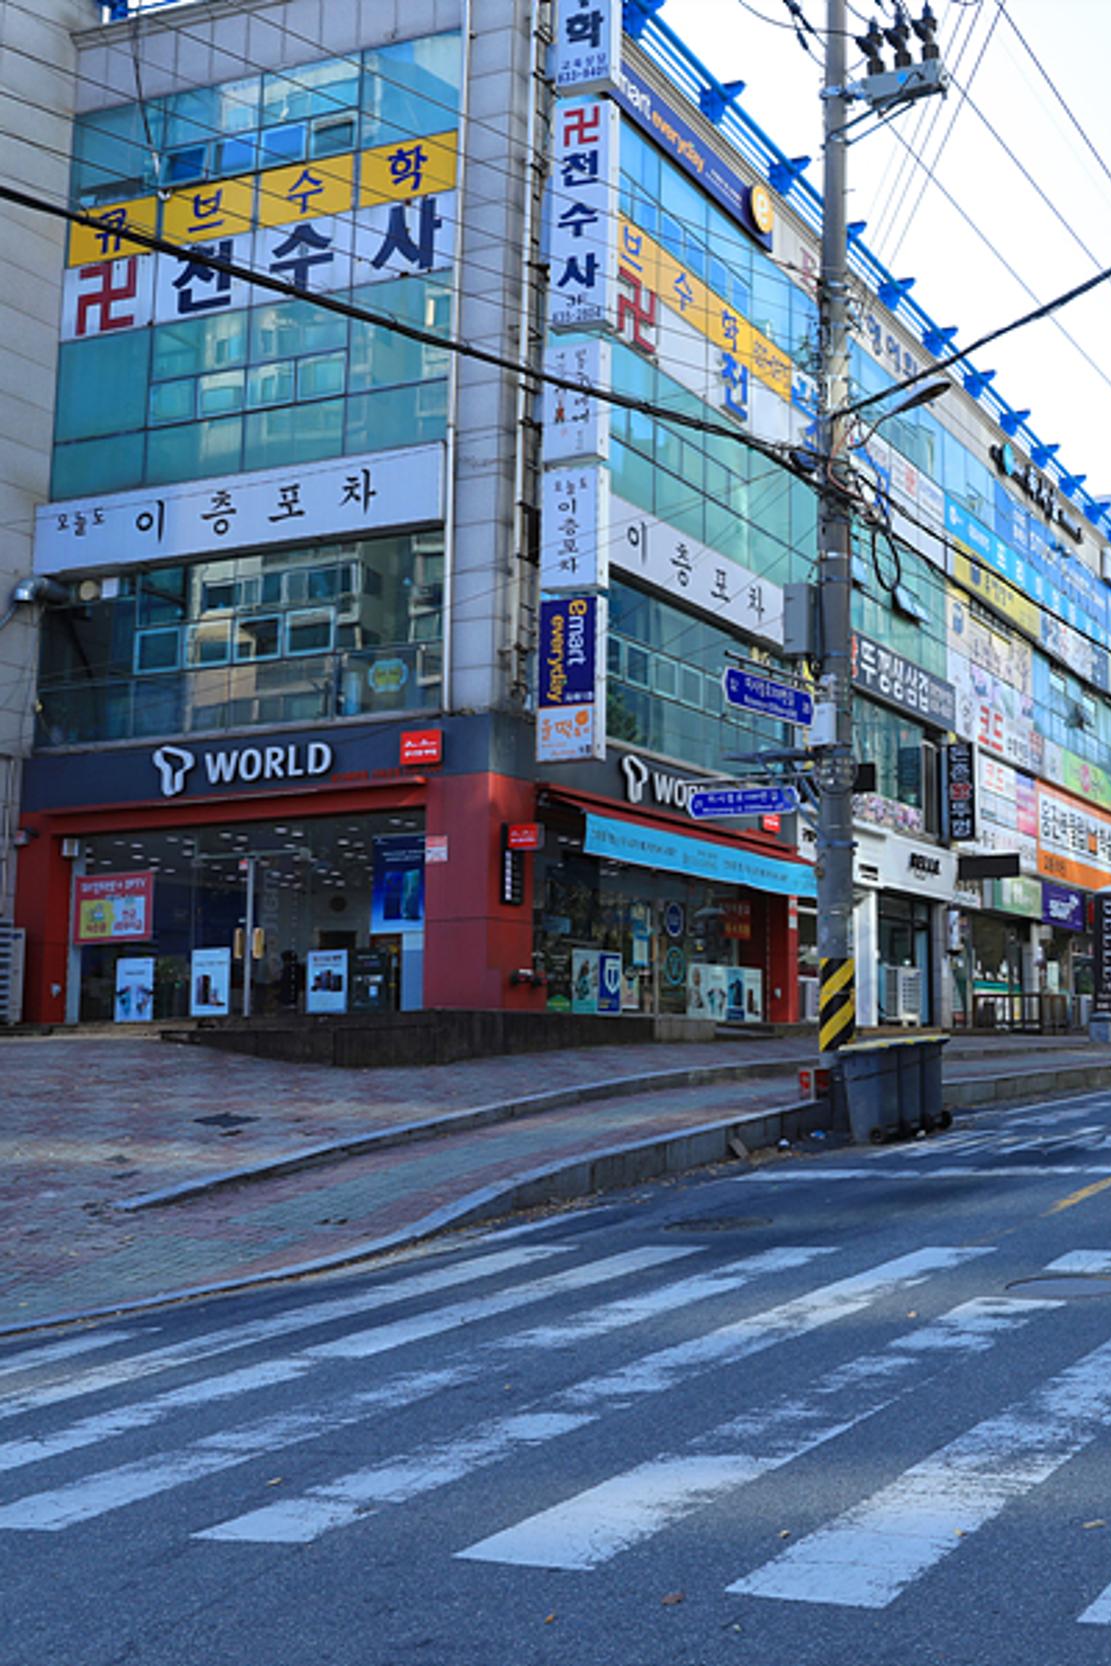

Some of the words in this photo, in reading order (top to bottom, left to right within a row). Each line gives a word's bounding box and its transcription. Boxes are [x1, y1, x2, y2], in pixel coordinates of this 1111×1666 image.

[136, 468, 376, 542] 이층포차
[626, 521, 765, 623] 이층포차
[205, 743, 332, 784] WORLD
